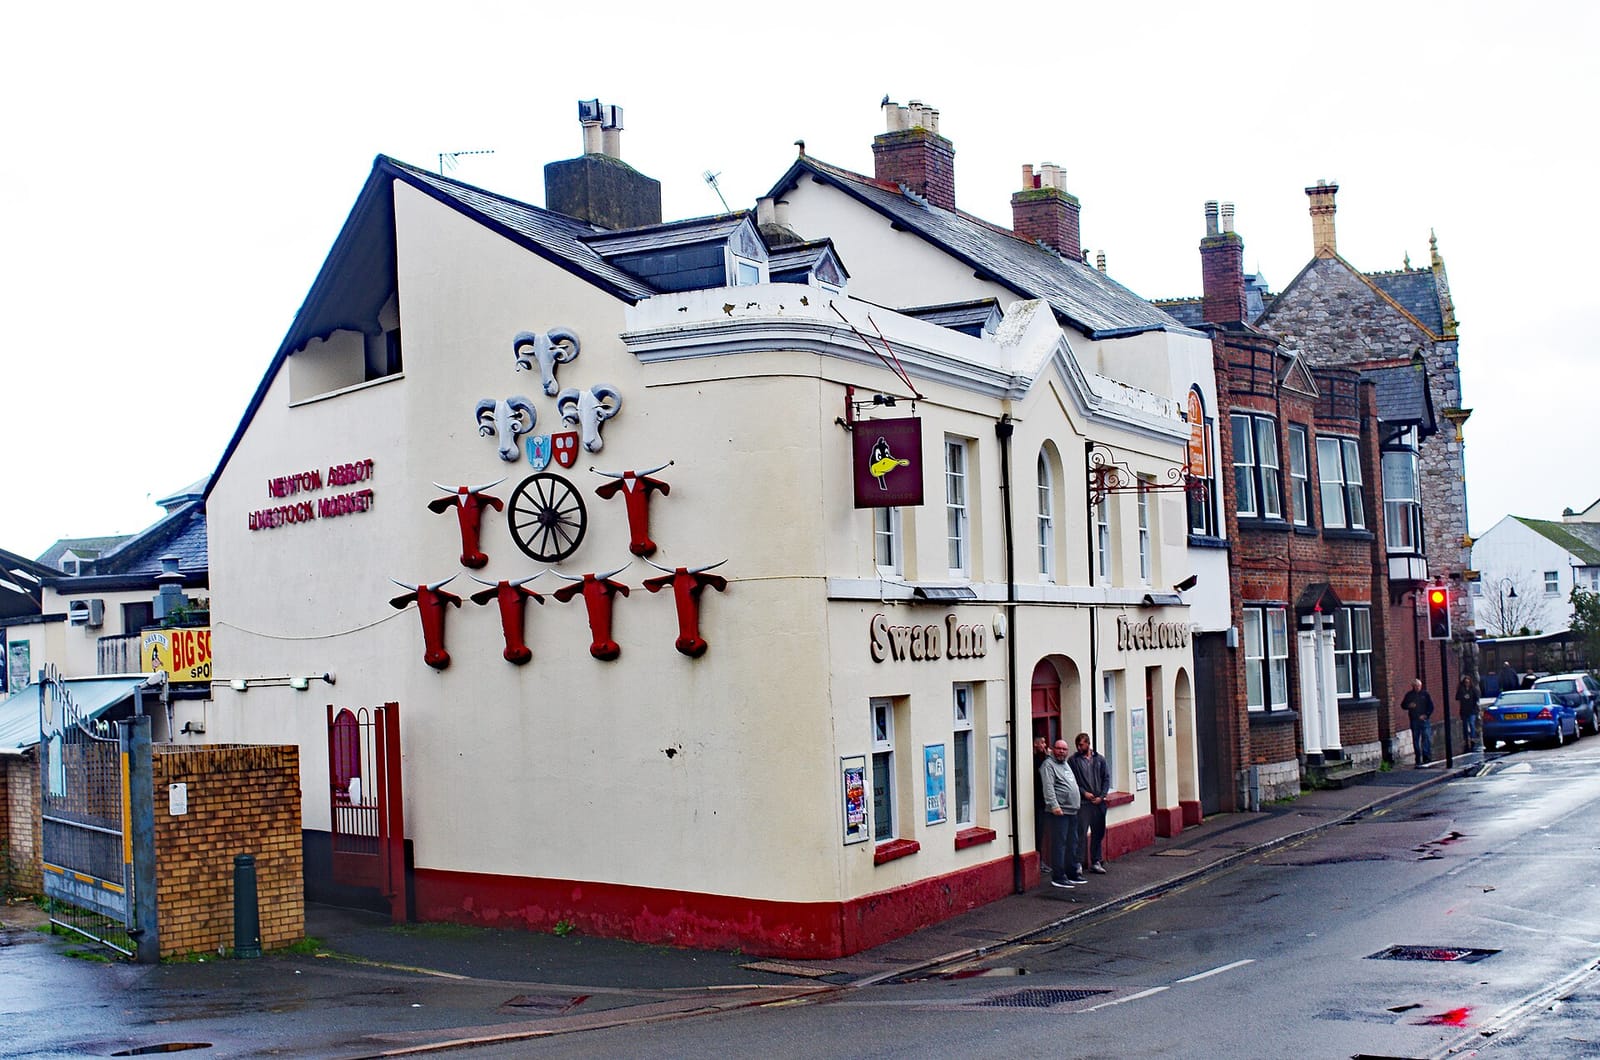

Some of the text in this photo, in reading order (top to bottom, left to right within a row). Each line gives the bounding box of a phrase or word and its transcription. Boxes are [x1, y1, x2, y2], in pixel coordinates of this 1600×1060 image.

[268, 458, 374, 498] NEWTON ABBOT
[248, 489, 374, 531] LIVESTOCK MARKET
[171, 630, 195, 673] BIG
[870, 613, 987, 664] Swan Inn
[1117, 614, 1189, 652] Freehouse
[191, 661, 212, 678] SPO
